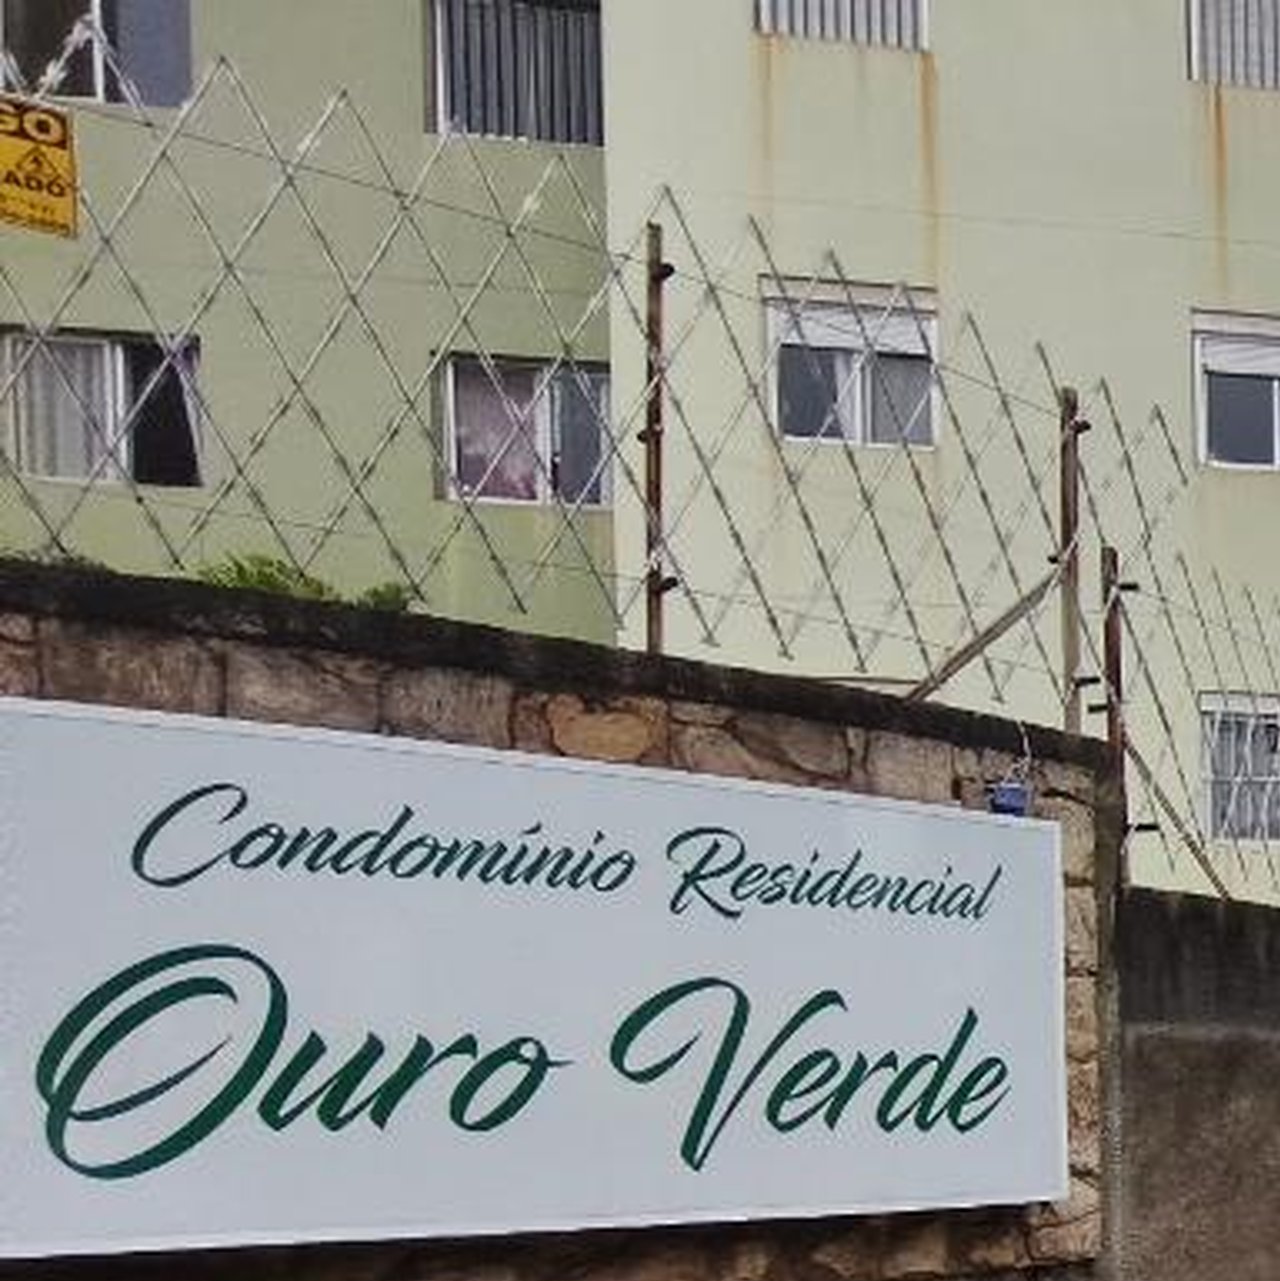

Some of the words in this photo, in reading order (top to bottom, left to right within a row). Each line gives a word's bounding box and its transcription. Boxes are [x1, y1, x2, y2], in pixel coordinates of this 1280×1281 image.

[131, 783, 637, 892] Condomínio
[666, 826, 1003, 920] Residencial
[36, 943, 574, 1181] Ouro
[609, 976, 1012, 1172] Verde
